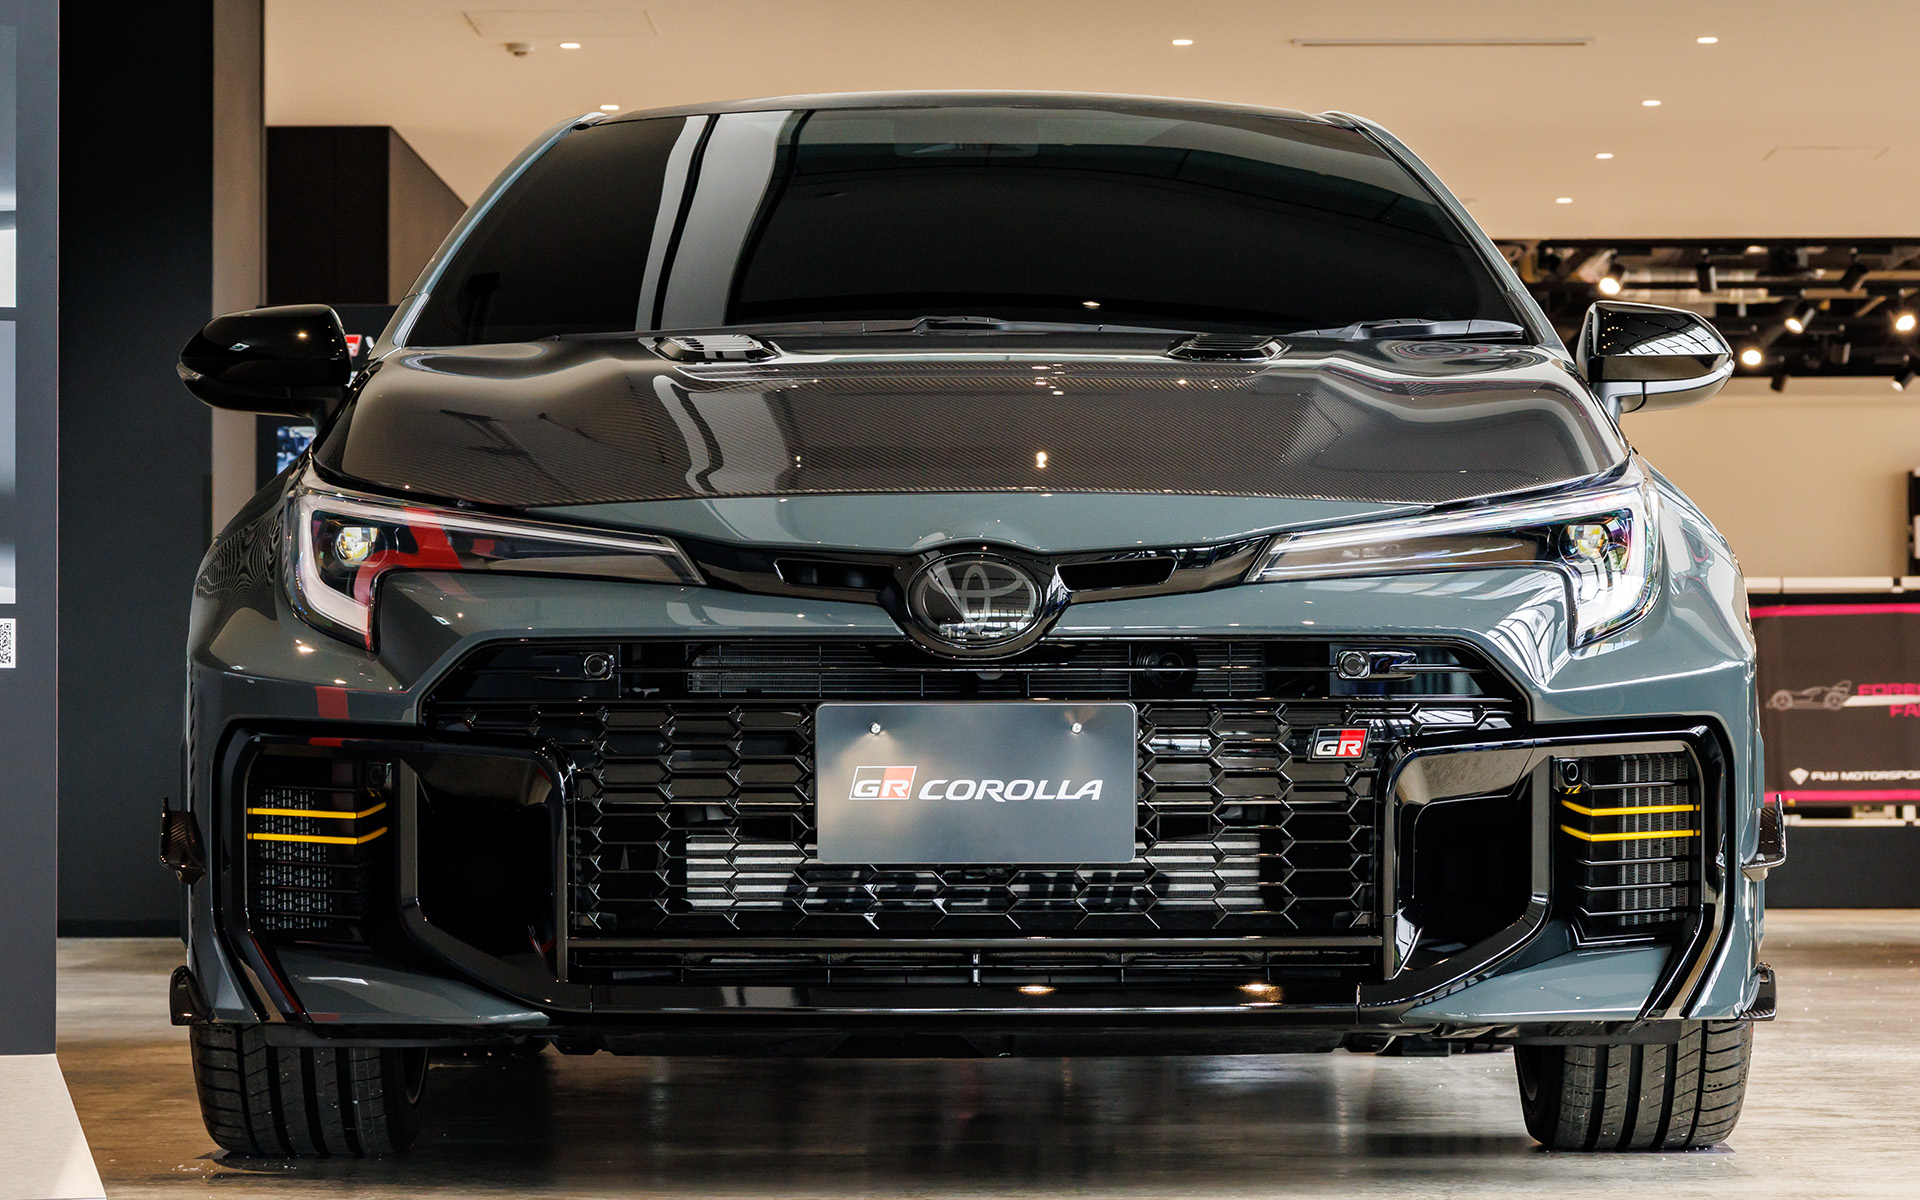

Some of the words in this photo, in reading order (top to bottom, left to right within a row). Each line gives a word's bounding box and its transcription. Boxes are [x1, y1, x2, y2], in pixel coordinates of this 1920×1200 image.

[1890, 703, 1920, 718] FA
[1316, 740, 1362, 756] GR
[1810, 771, 1840, 781] FUJI
[852, 779, 911, 798] GR
[918, 779, 1104, 803] COROLLA
